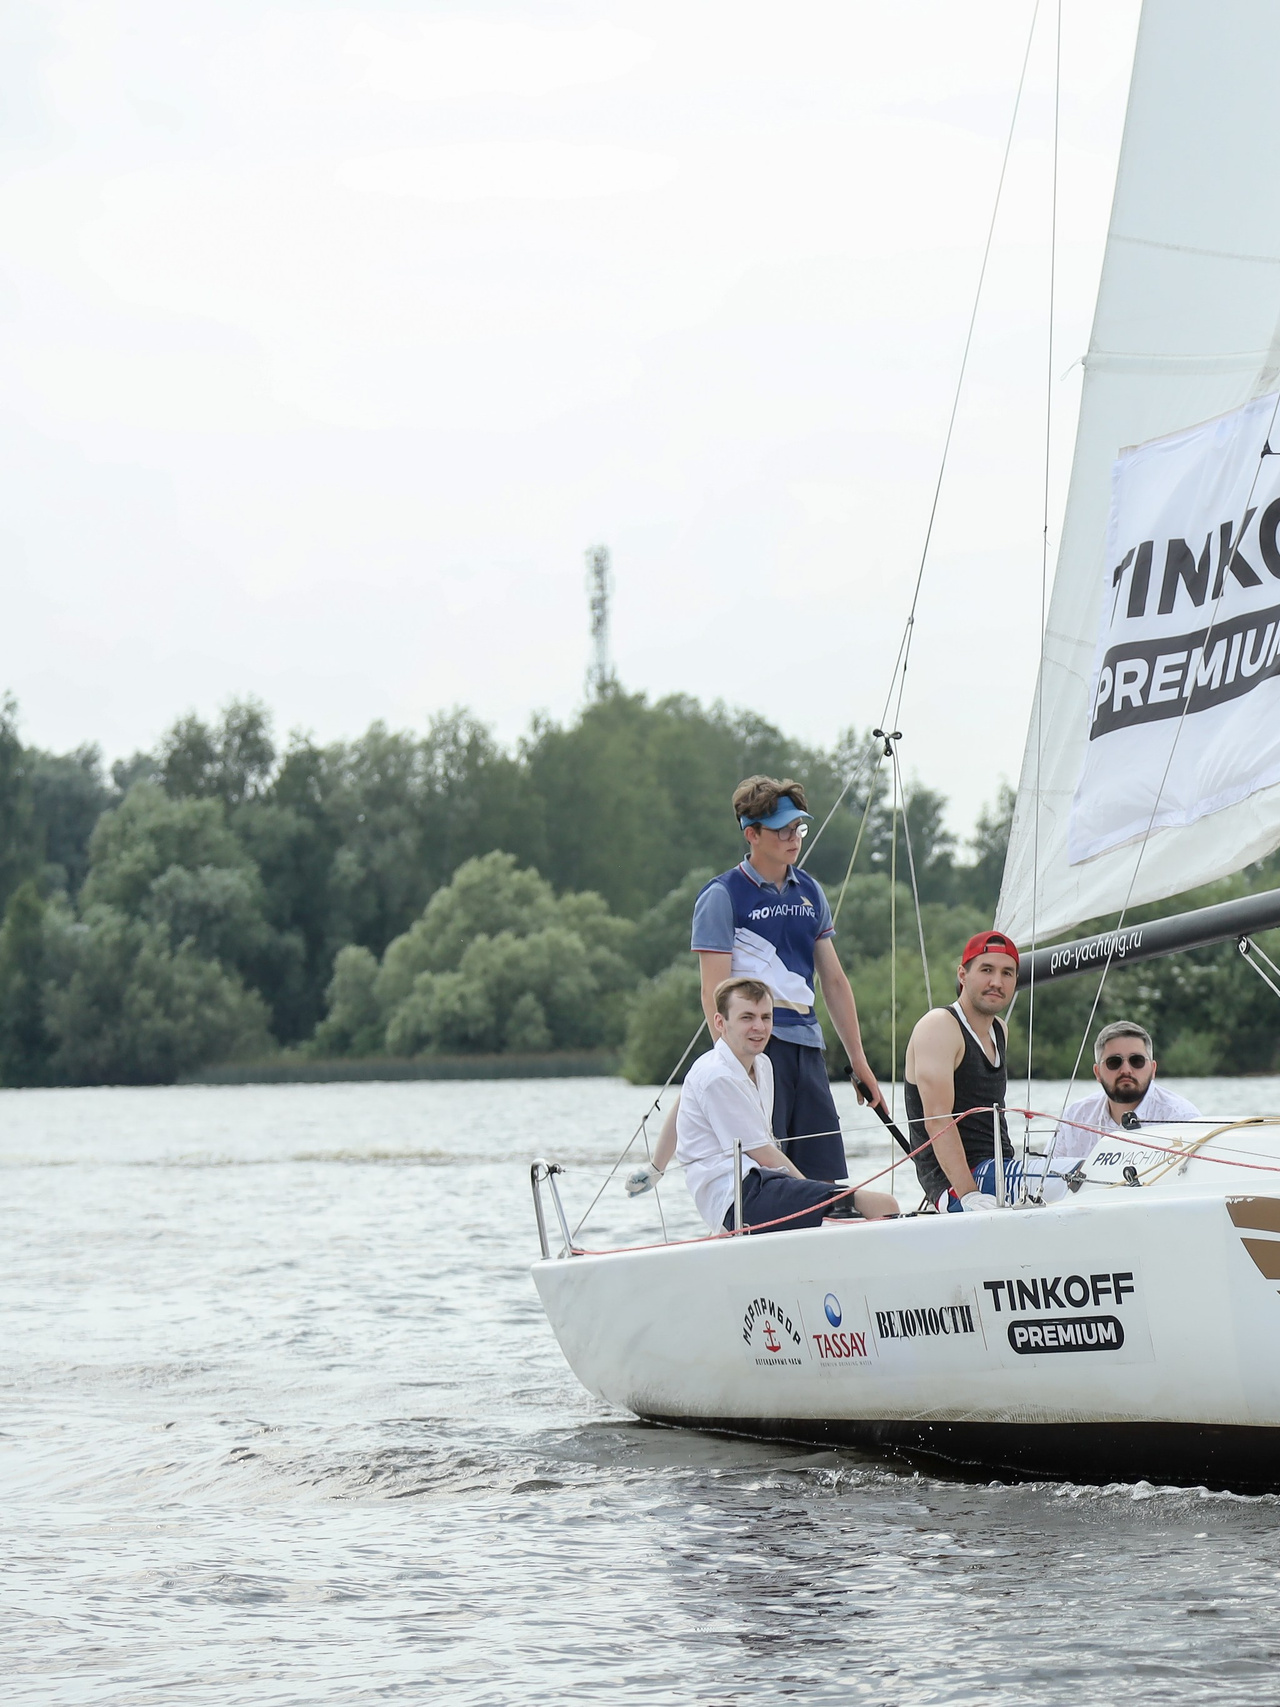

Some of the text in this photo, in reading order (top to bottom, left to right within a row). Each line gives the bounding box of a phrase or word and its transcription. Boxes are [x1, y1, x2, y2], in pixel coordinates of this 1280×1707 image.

[1050, 930, 1143, 975] pro-yachting.ru
[983, 1272, 1135, 1312] TINKOFF
[743, 1298, 801, 1346] МОРПРИБОР
[875, 1305, 975, 1341] ВЕДОМОСТИ
[1014, 1322, 1118, 1348] PREMIUM
[813, 1332, 868, 1359] TASSAY
